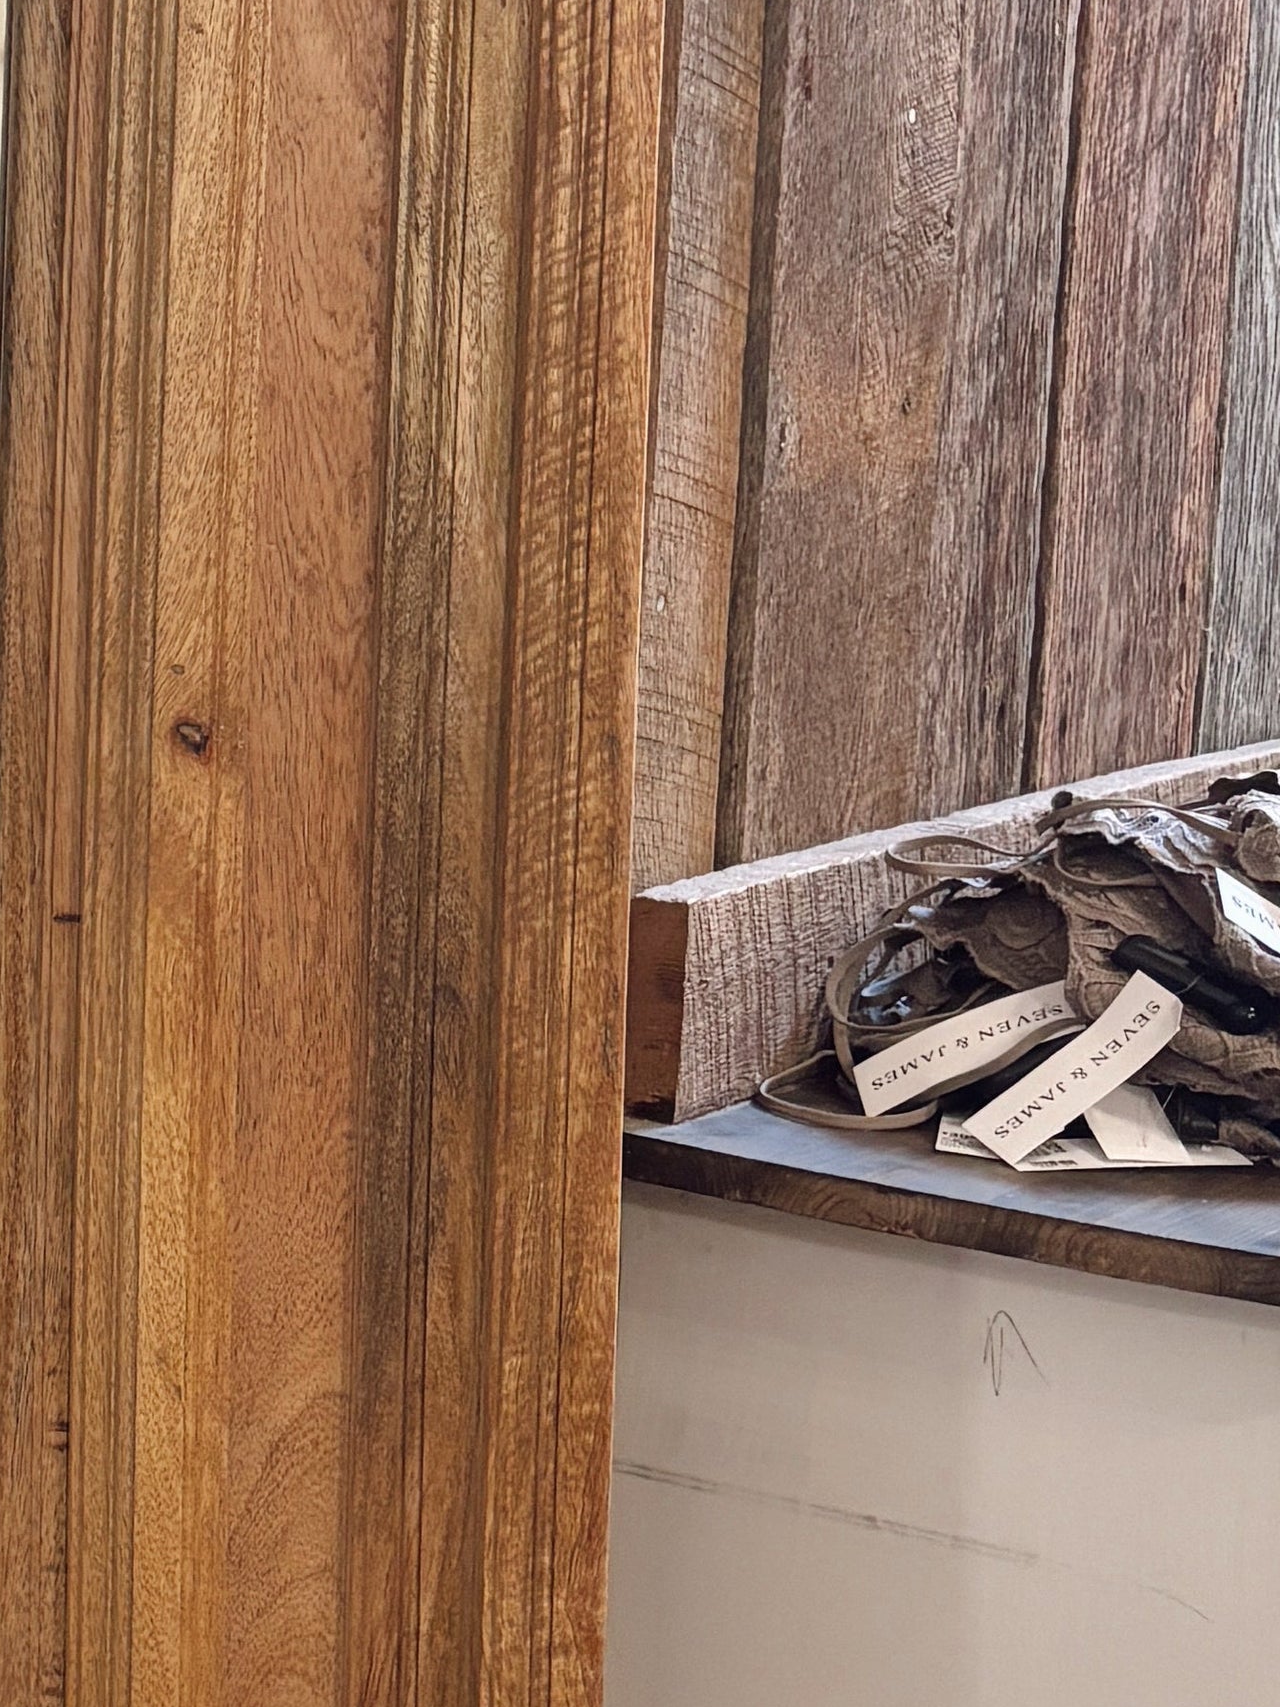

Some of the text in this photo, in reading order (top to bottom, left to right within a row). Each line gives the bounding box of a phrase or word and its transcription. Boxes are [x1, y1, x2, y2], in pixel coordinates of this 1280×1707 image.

[871, 1003, 1064, 1091] SEVEN & JAMES
[994, 1000, 1161, 1139] SEVEN & JAMES
